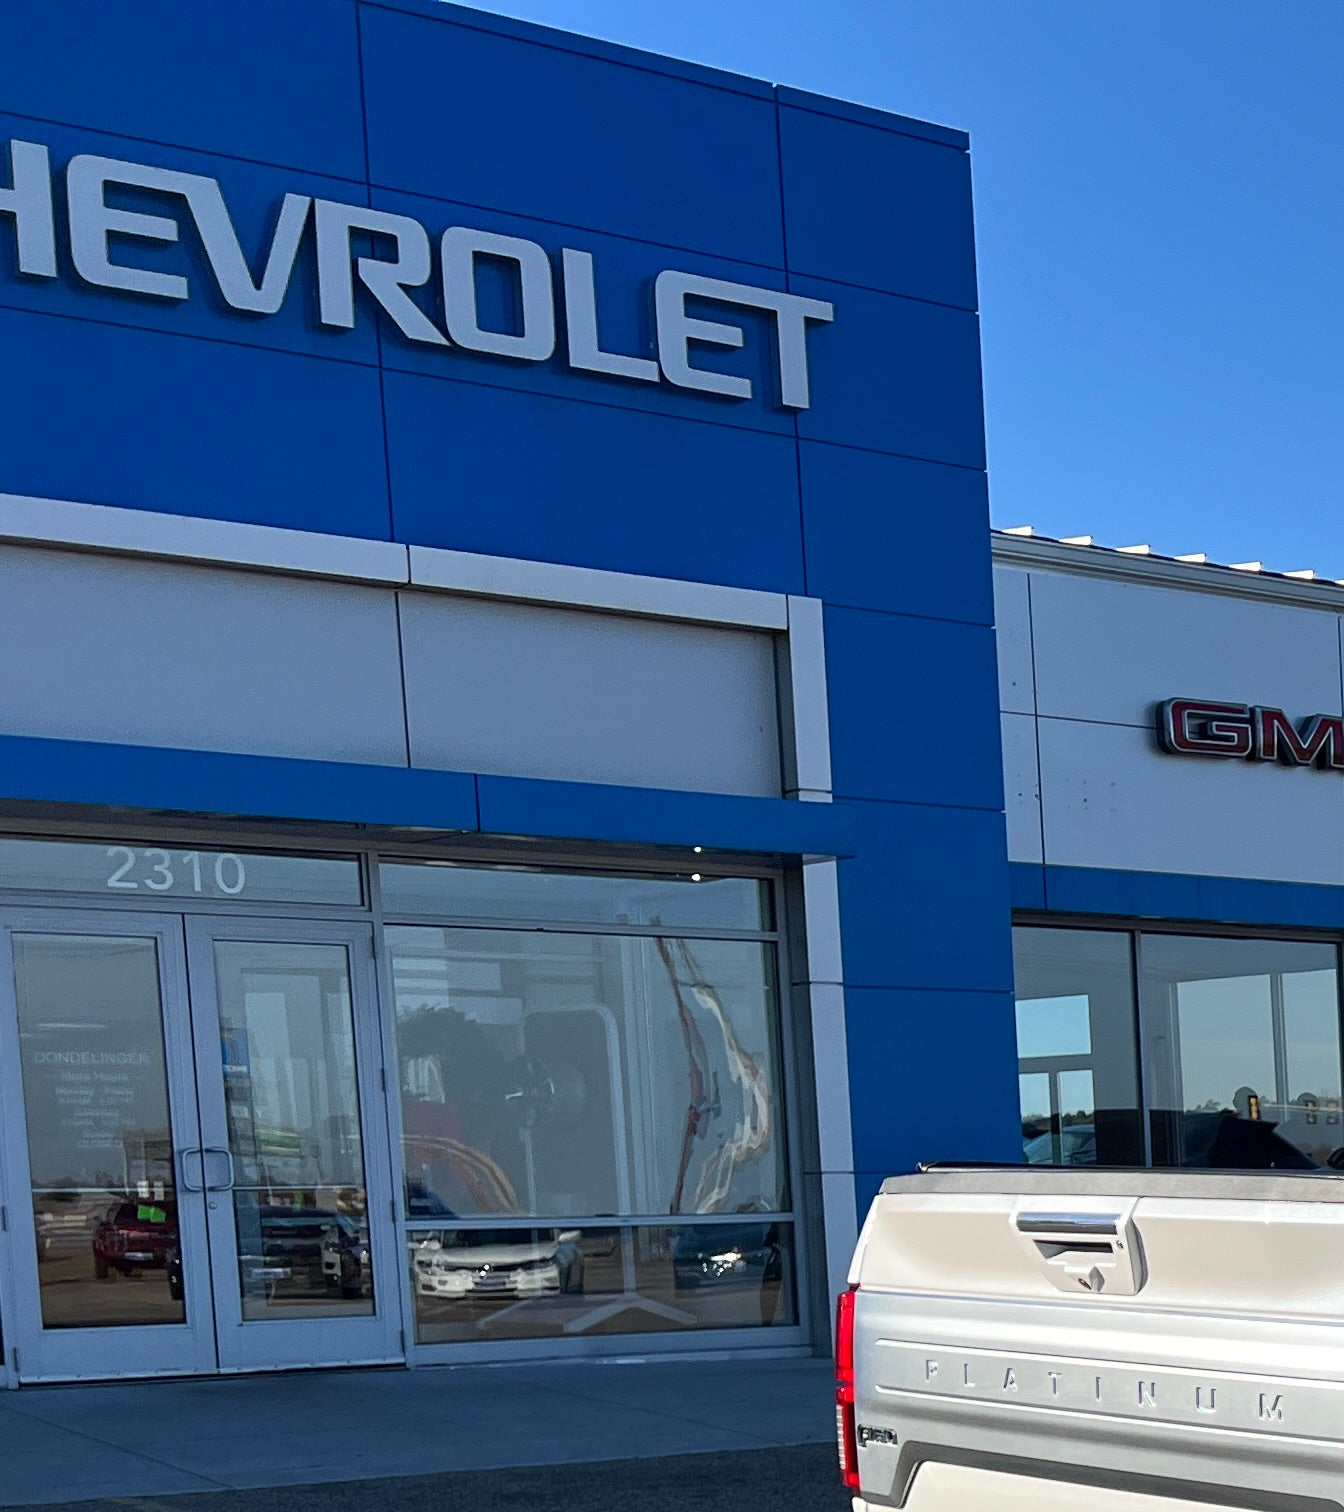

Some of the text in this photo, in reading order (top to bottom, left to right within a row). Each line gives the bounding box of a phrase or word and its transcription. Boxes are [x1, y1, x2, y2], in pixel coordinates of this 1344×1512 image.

[106, 846, 246, 894] 2310
[34, 1051, 150, 1064] DONDELINGER
[925, 1359, 1284, 1422] PLATINUM
